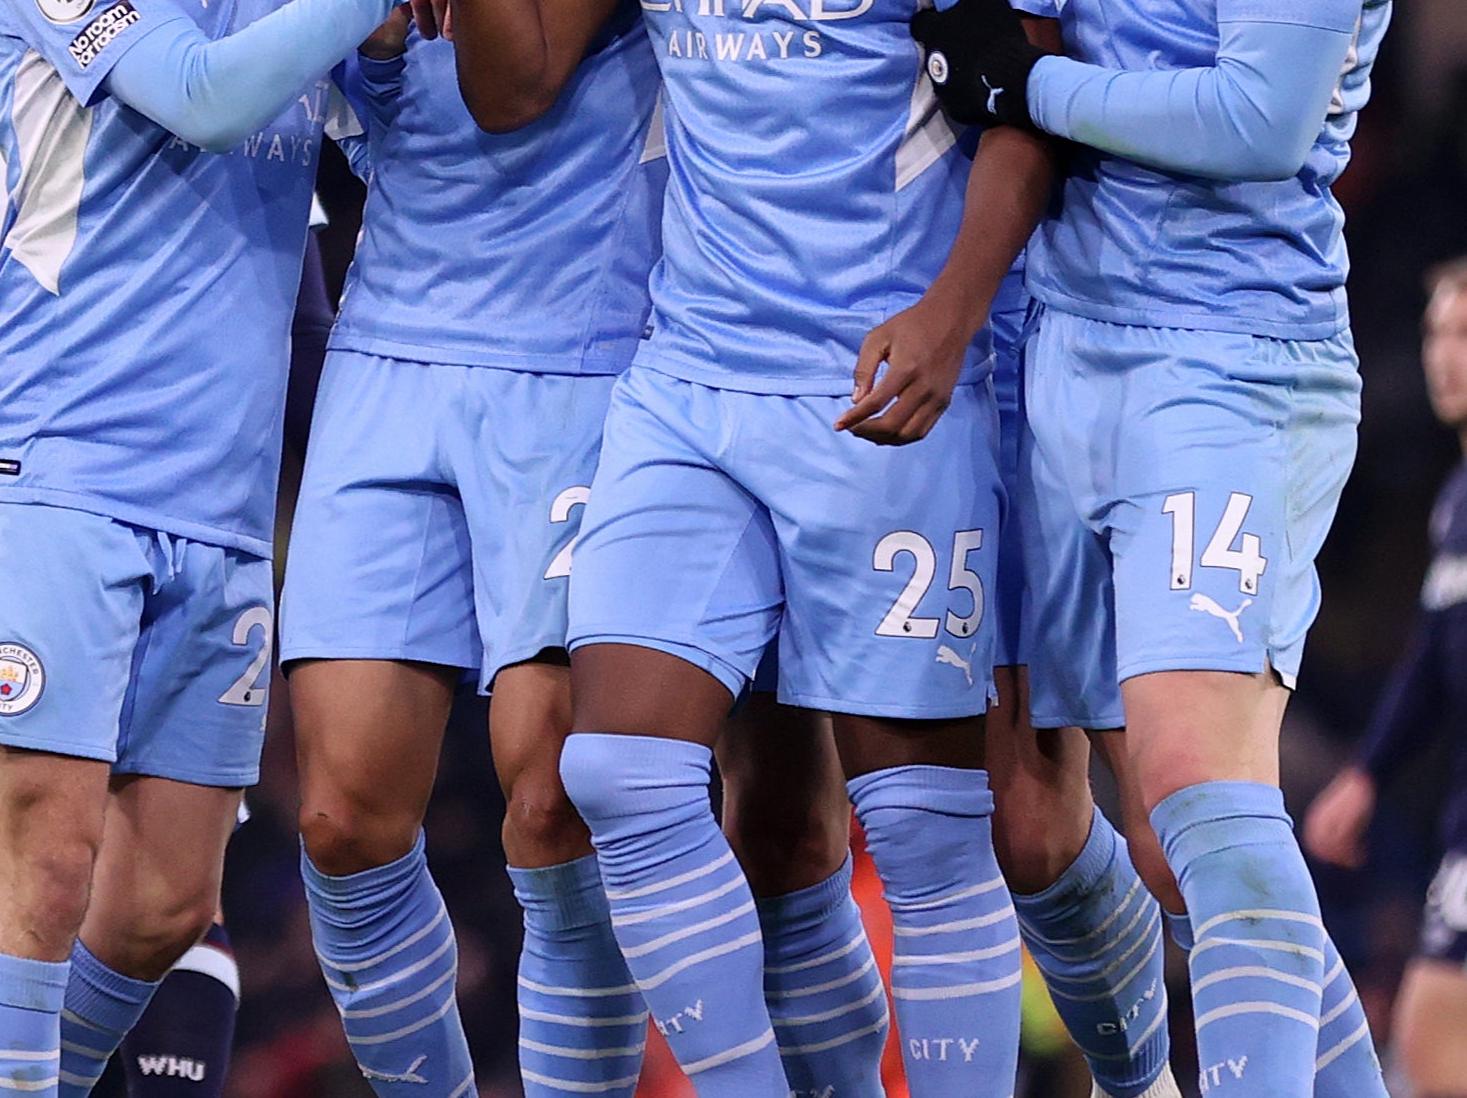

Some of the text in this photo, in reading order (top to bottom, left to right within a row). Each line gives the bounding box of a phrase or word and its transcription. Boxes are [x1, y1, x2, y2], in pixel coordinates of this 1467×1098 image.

[68, 4, 129, 58] No room
[91, 10, 141, 52] racism
[668, 29, 822, 61] AIRWAYS
[543, 485, 591, 580] 2
[1161, 491, 1268, 596] 14
[872, 528, 985, 639] 25
[137, 1053, 206, 1081] WHU
[909, 1037, 980, 1062] CITY
